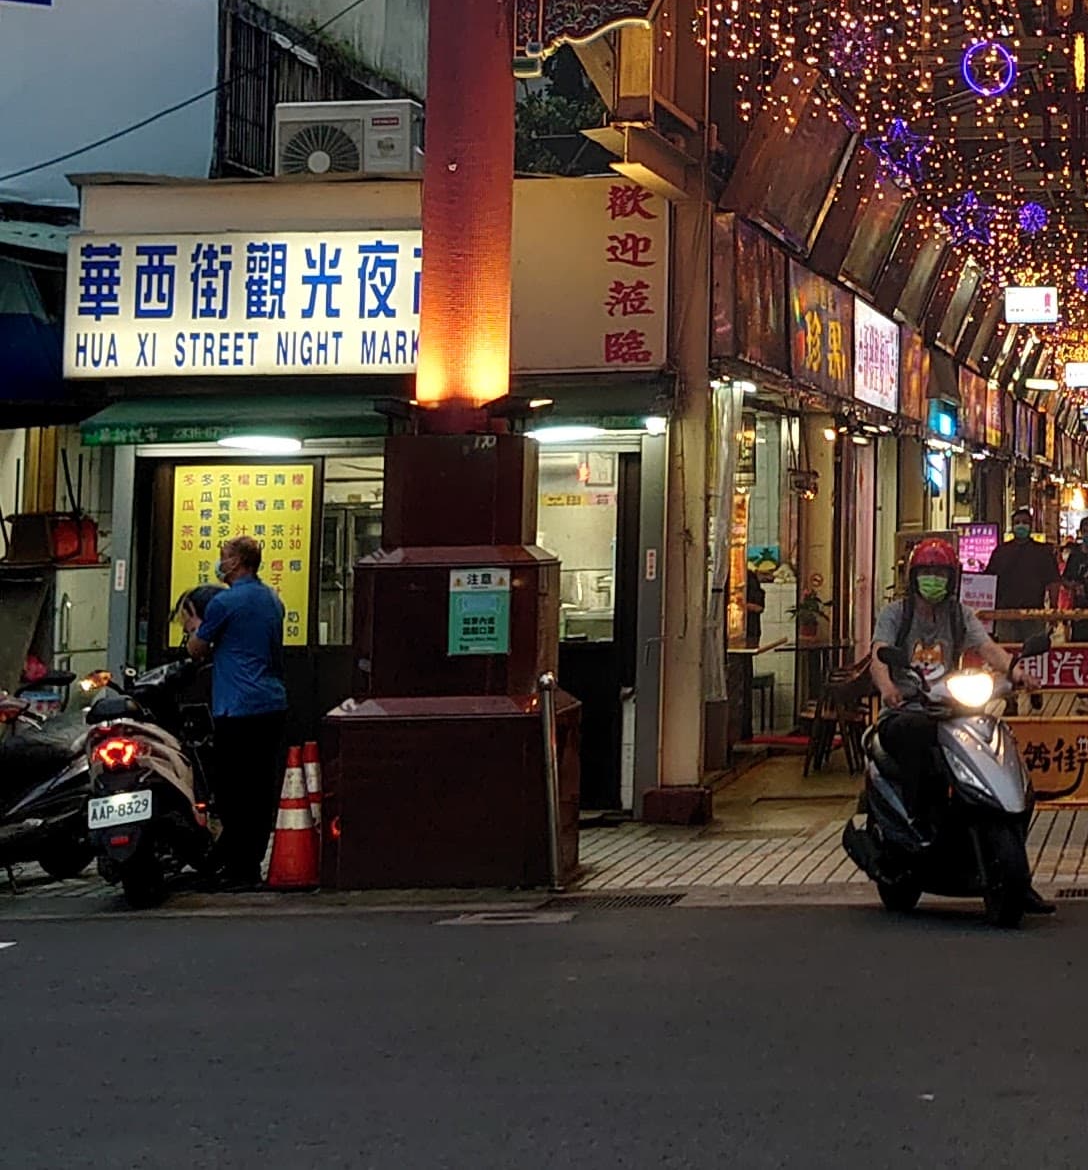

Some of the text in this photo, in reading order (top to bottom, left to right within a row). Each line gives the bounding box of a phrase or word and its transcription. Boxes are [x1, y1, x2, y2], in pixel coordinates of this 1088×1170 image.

[77, 241, 421, 321] 華西街觀光夜
[75, 332, 118, 368] HUA
[135, 332, 157, 367] XI
[174, 332, 258, 367] STREET
[276, 332, 343, 366] NIGHT
[181, 540, 193, 551] 30
[199, 540, 211, 550] 40
[271, 540, 283, 550] 30
[289, 540, 301, 550] 30
[467, 573, 492, 585] 注意
[287, 626, 299, 637] 50
[91, 798, 149, 822] AAP-8329
